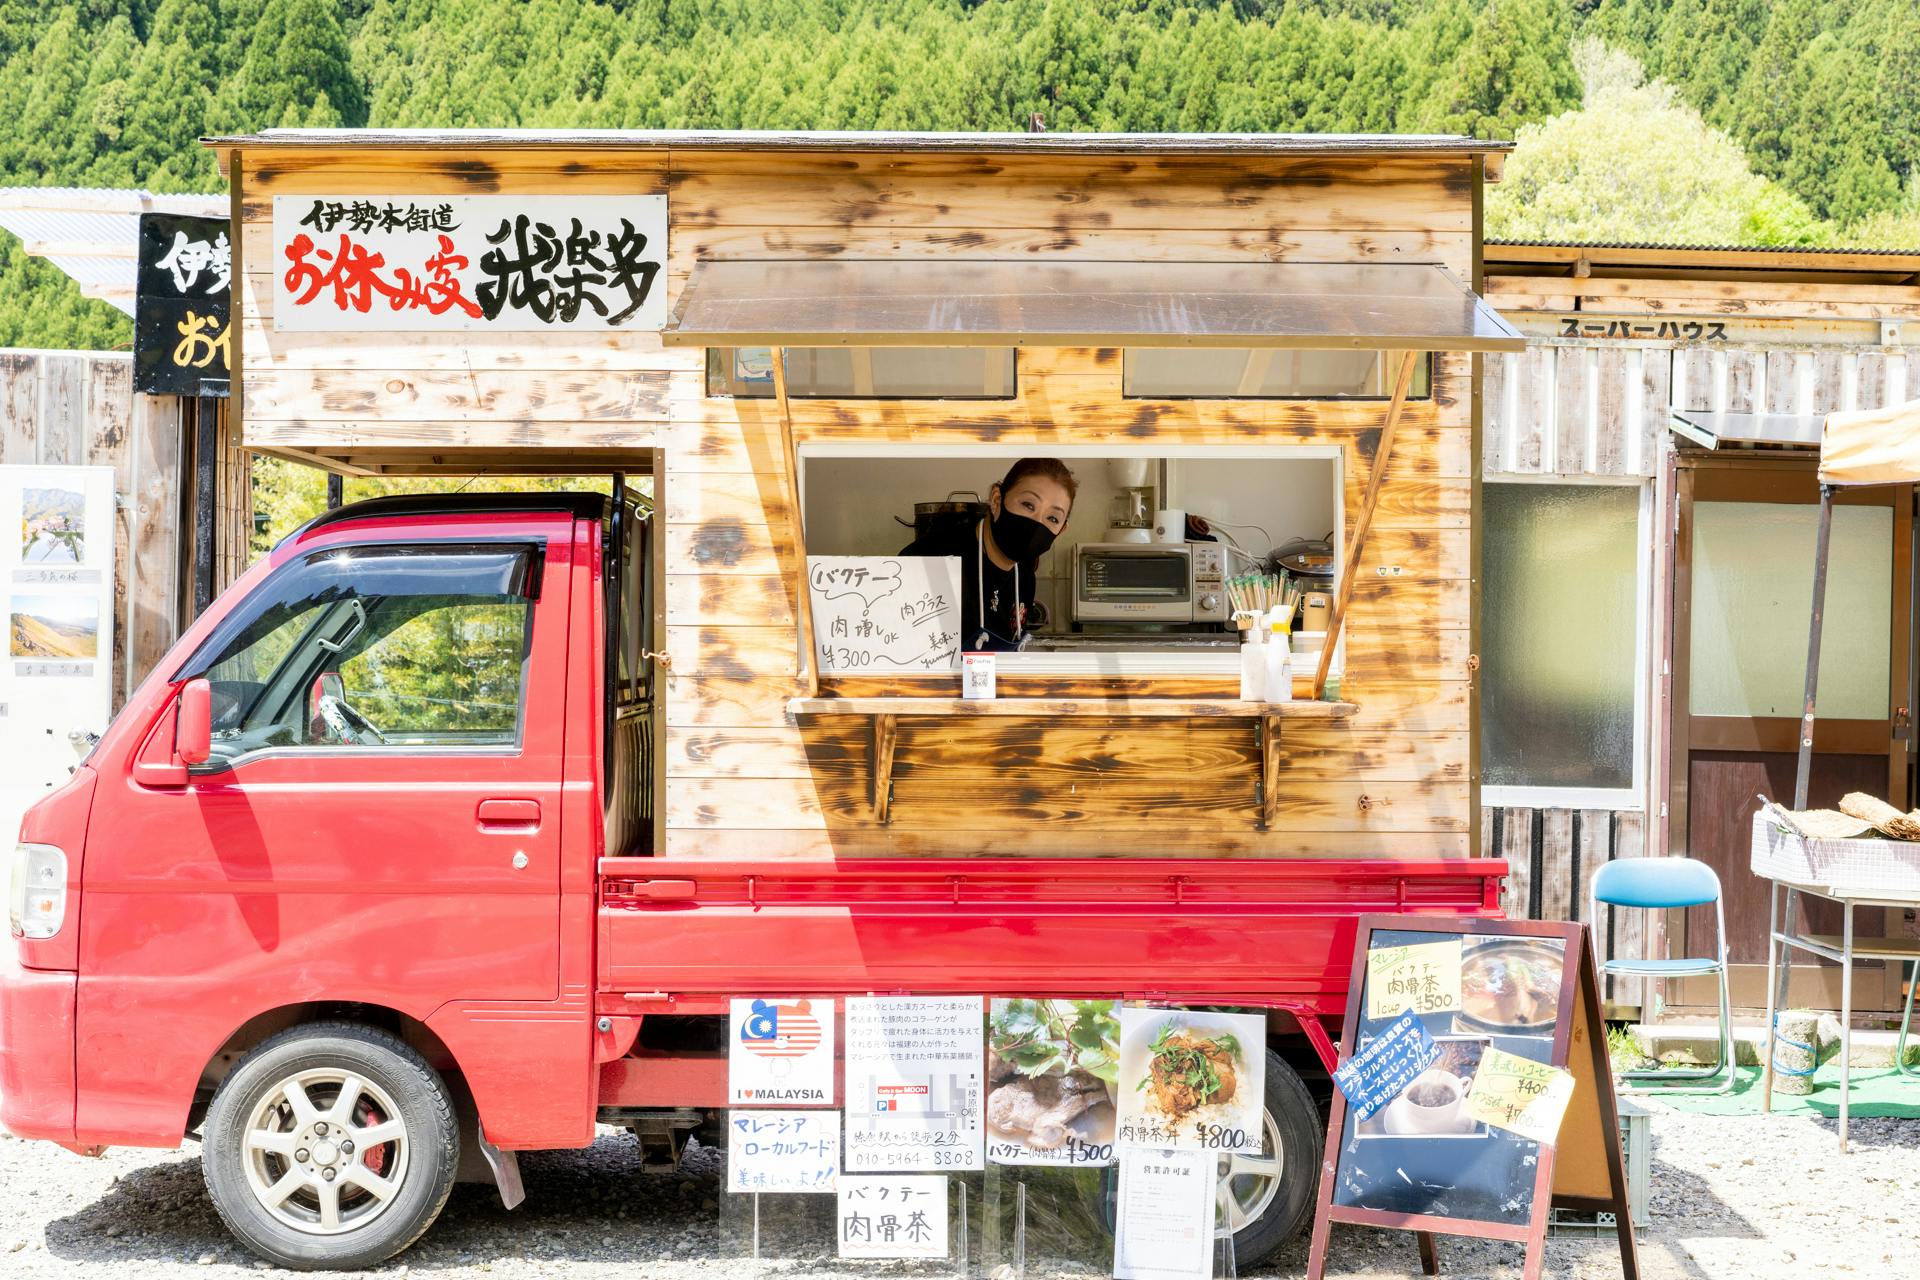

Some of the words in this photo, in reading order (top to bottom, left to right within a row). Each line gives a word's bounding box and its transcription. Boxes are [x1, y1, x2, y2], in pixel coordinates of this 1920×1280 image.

[300, 199, 464, 235] 伊勢本街道
[1562, 318, 1728, 341] スーパーハウス
[816, 567, 890, 587] バクテー
[900, 592, 947, 621] 肉プラス
[883, 633, 900, 645] OK
[822, 644, 871, 669] ¥300
[920, 646, 958, 670] yummy
[1392, 962, 1442, 976] バクテー
[1387, 974, 1440, 996] 肉骨茶
[755, 1089, 824, 1099] MALAYSIA
[734, 1117, 807, 1134] マレーシア
[745, 1140, 835, 1159] ローカルフード
[1066, 1135, 1113, 1164] ¥500
[1144, 1165, 1191, 1177] 営業許可証
[847, 1186, 932, 1202] バクテー
[843, 1210, 933, 1243] 肉骨茶
